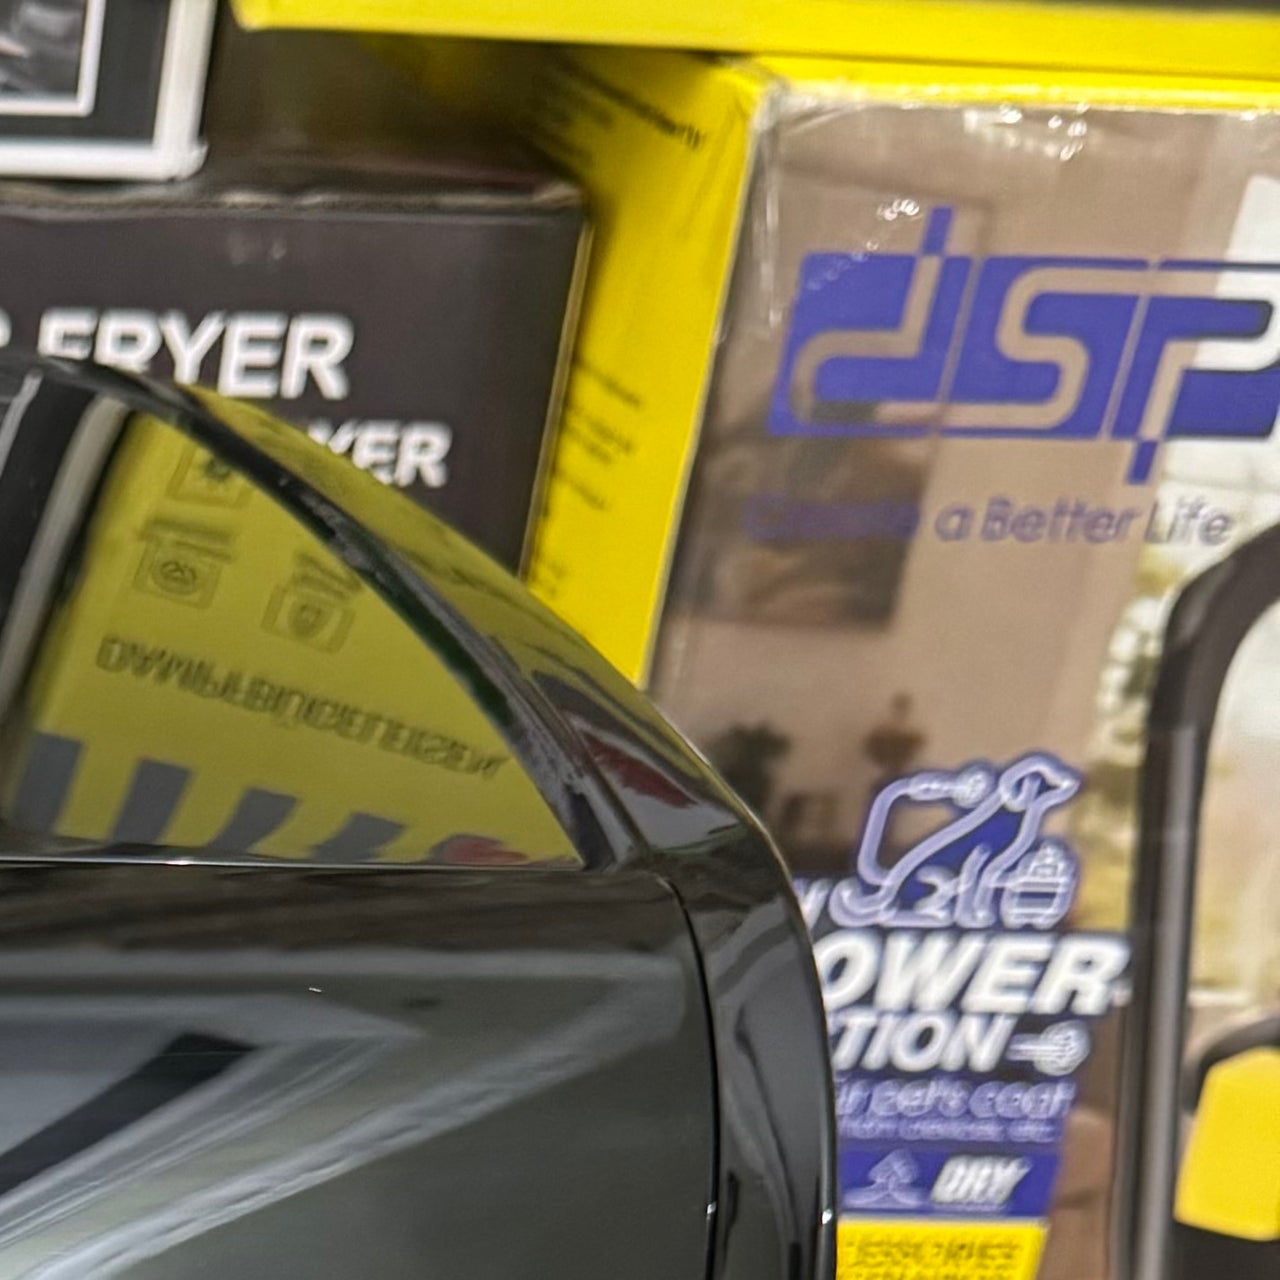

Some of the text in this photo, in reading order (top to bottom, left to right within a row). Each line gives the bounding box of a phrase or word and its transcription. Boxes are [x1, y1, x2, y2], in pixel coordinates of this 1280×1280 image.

[38, 306, 355, 400] FRYER
[980, 498, 1139, 544] Better
[1142, 498, 1234, 547] Life
[813, 933, 1130, 1016] OWER
[830, 1013, 1017, 1073] TION
